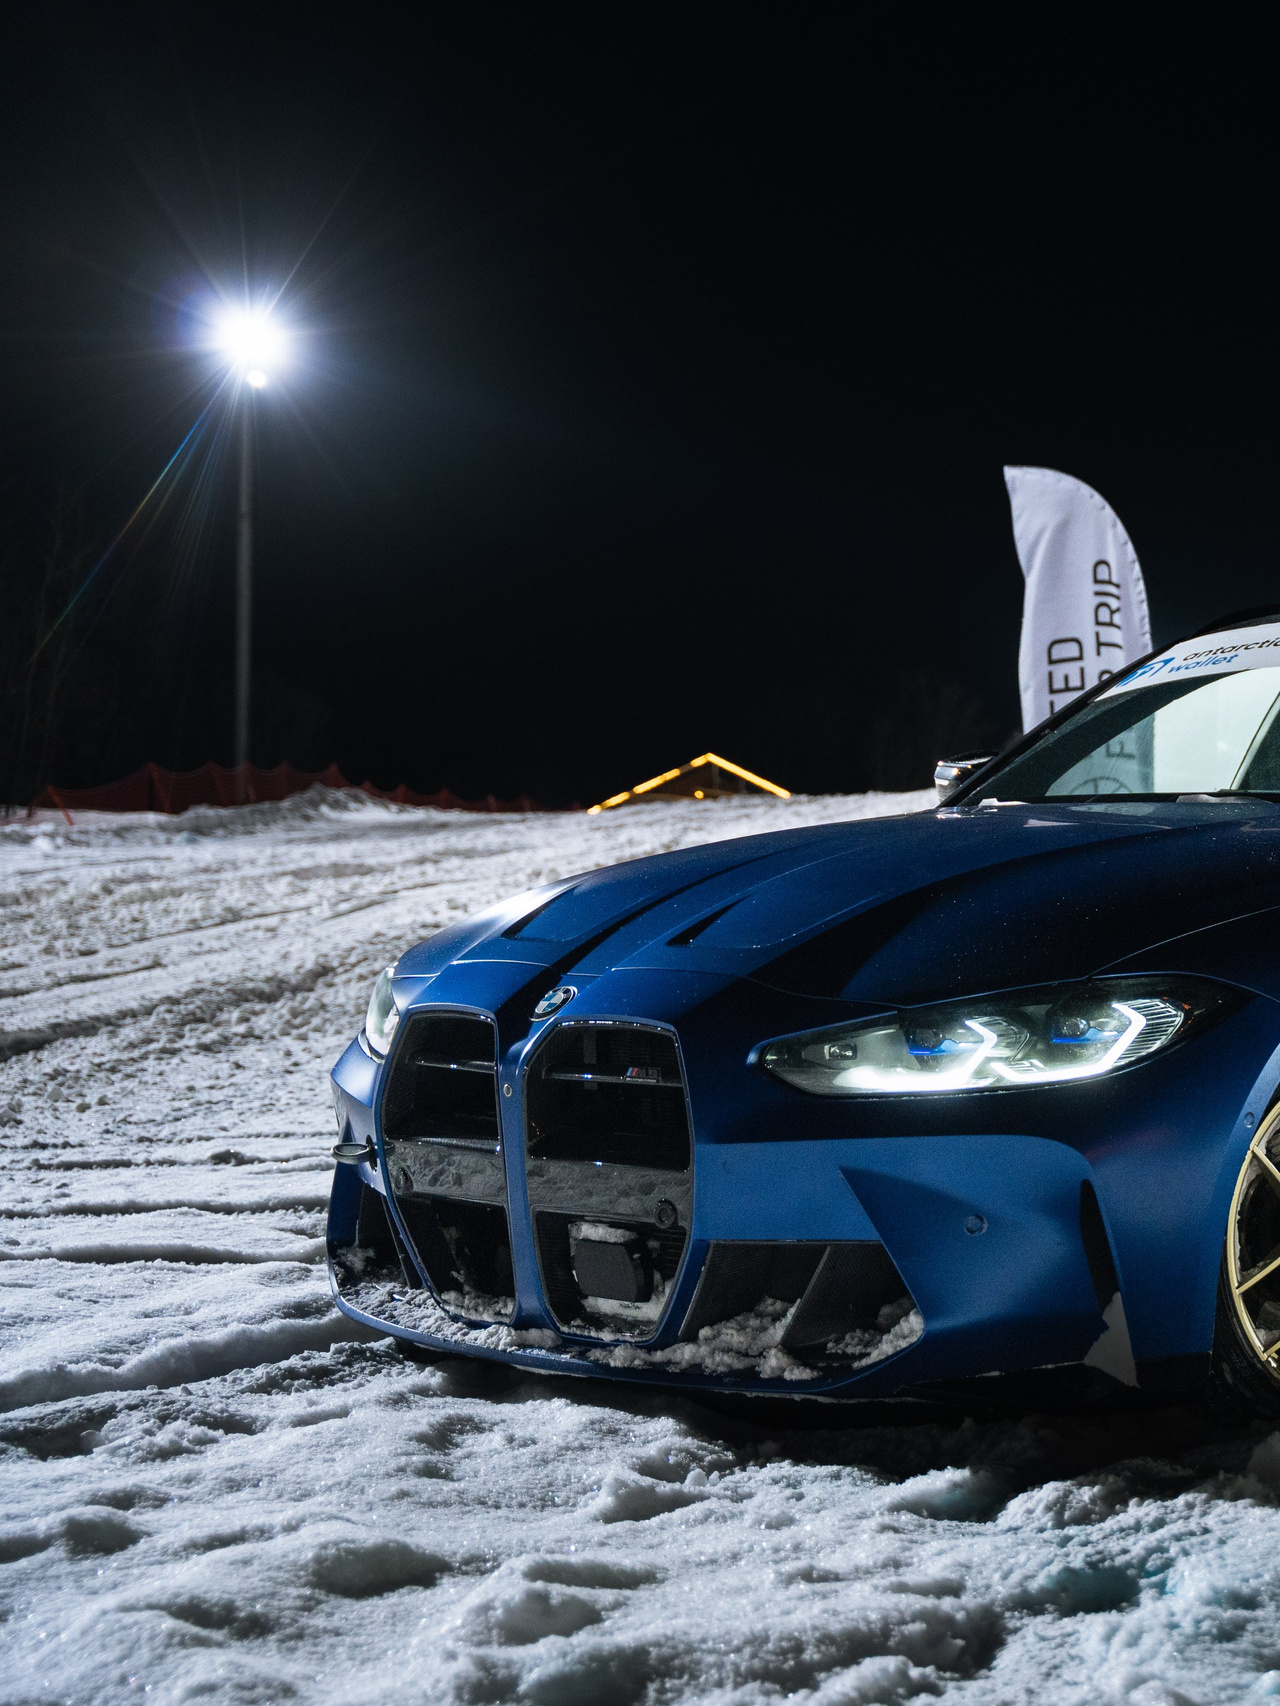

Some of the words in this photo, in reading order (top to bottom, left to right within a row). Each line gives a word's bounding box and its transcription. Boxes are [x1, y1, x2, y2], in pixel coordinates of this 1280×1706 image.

[1093, 559, 1123, 656] TRIP
[1047, 637, 1085, 716] ED
[1167, 653, 1240, 674] wallet
